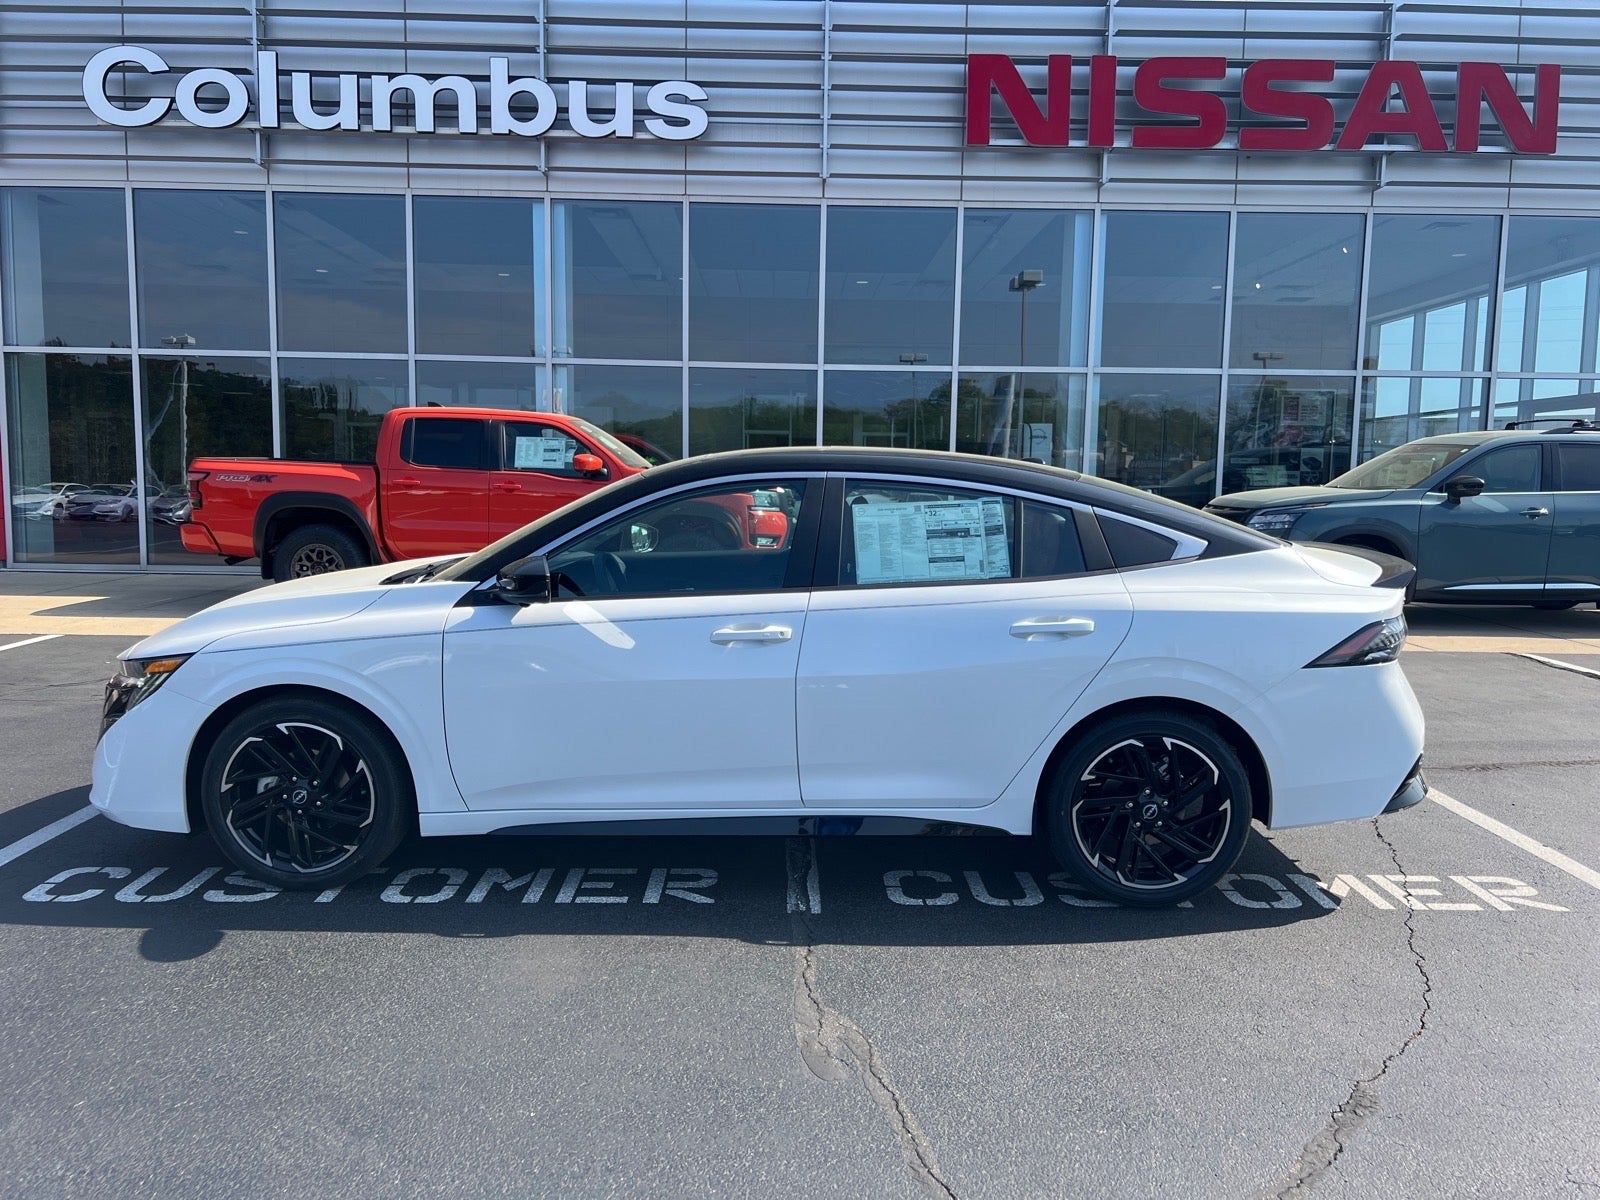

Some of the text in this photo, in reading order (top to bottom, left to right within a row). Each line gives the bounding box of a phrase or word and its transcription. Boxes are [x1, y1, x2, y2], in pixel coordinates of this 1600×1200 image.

[82, 45, 710, 141] Columbus
[966, 54, 1562, 155] NISSAN
[883, 869, 1569, 912] CUOMER
